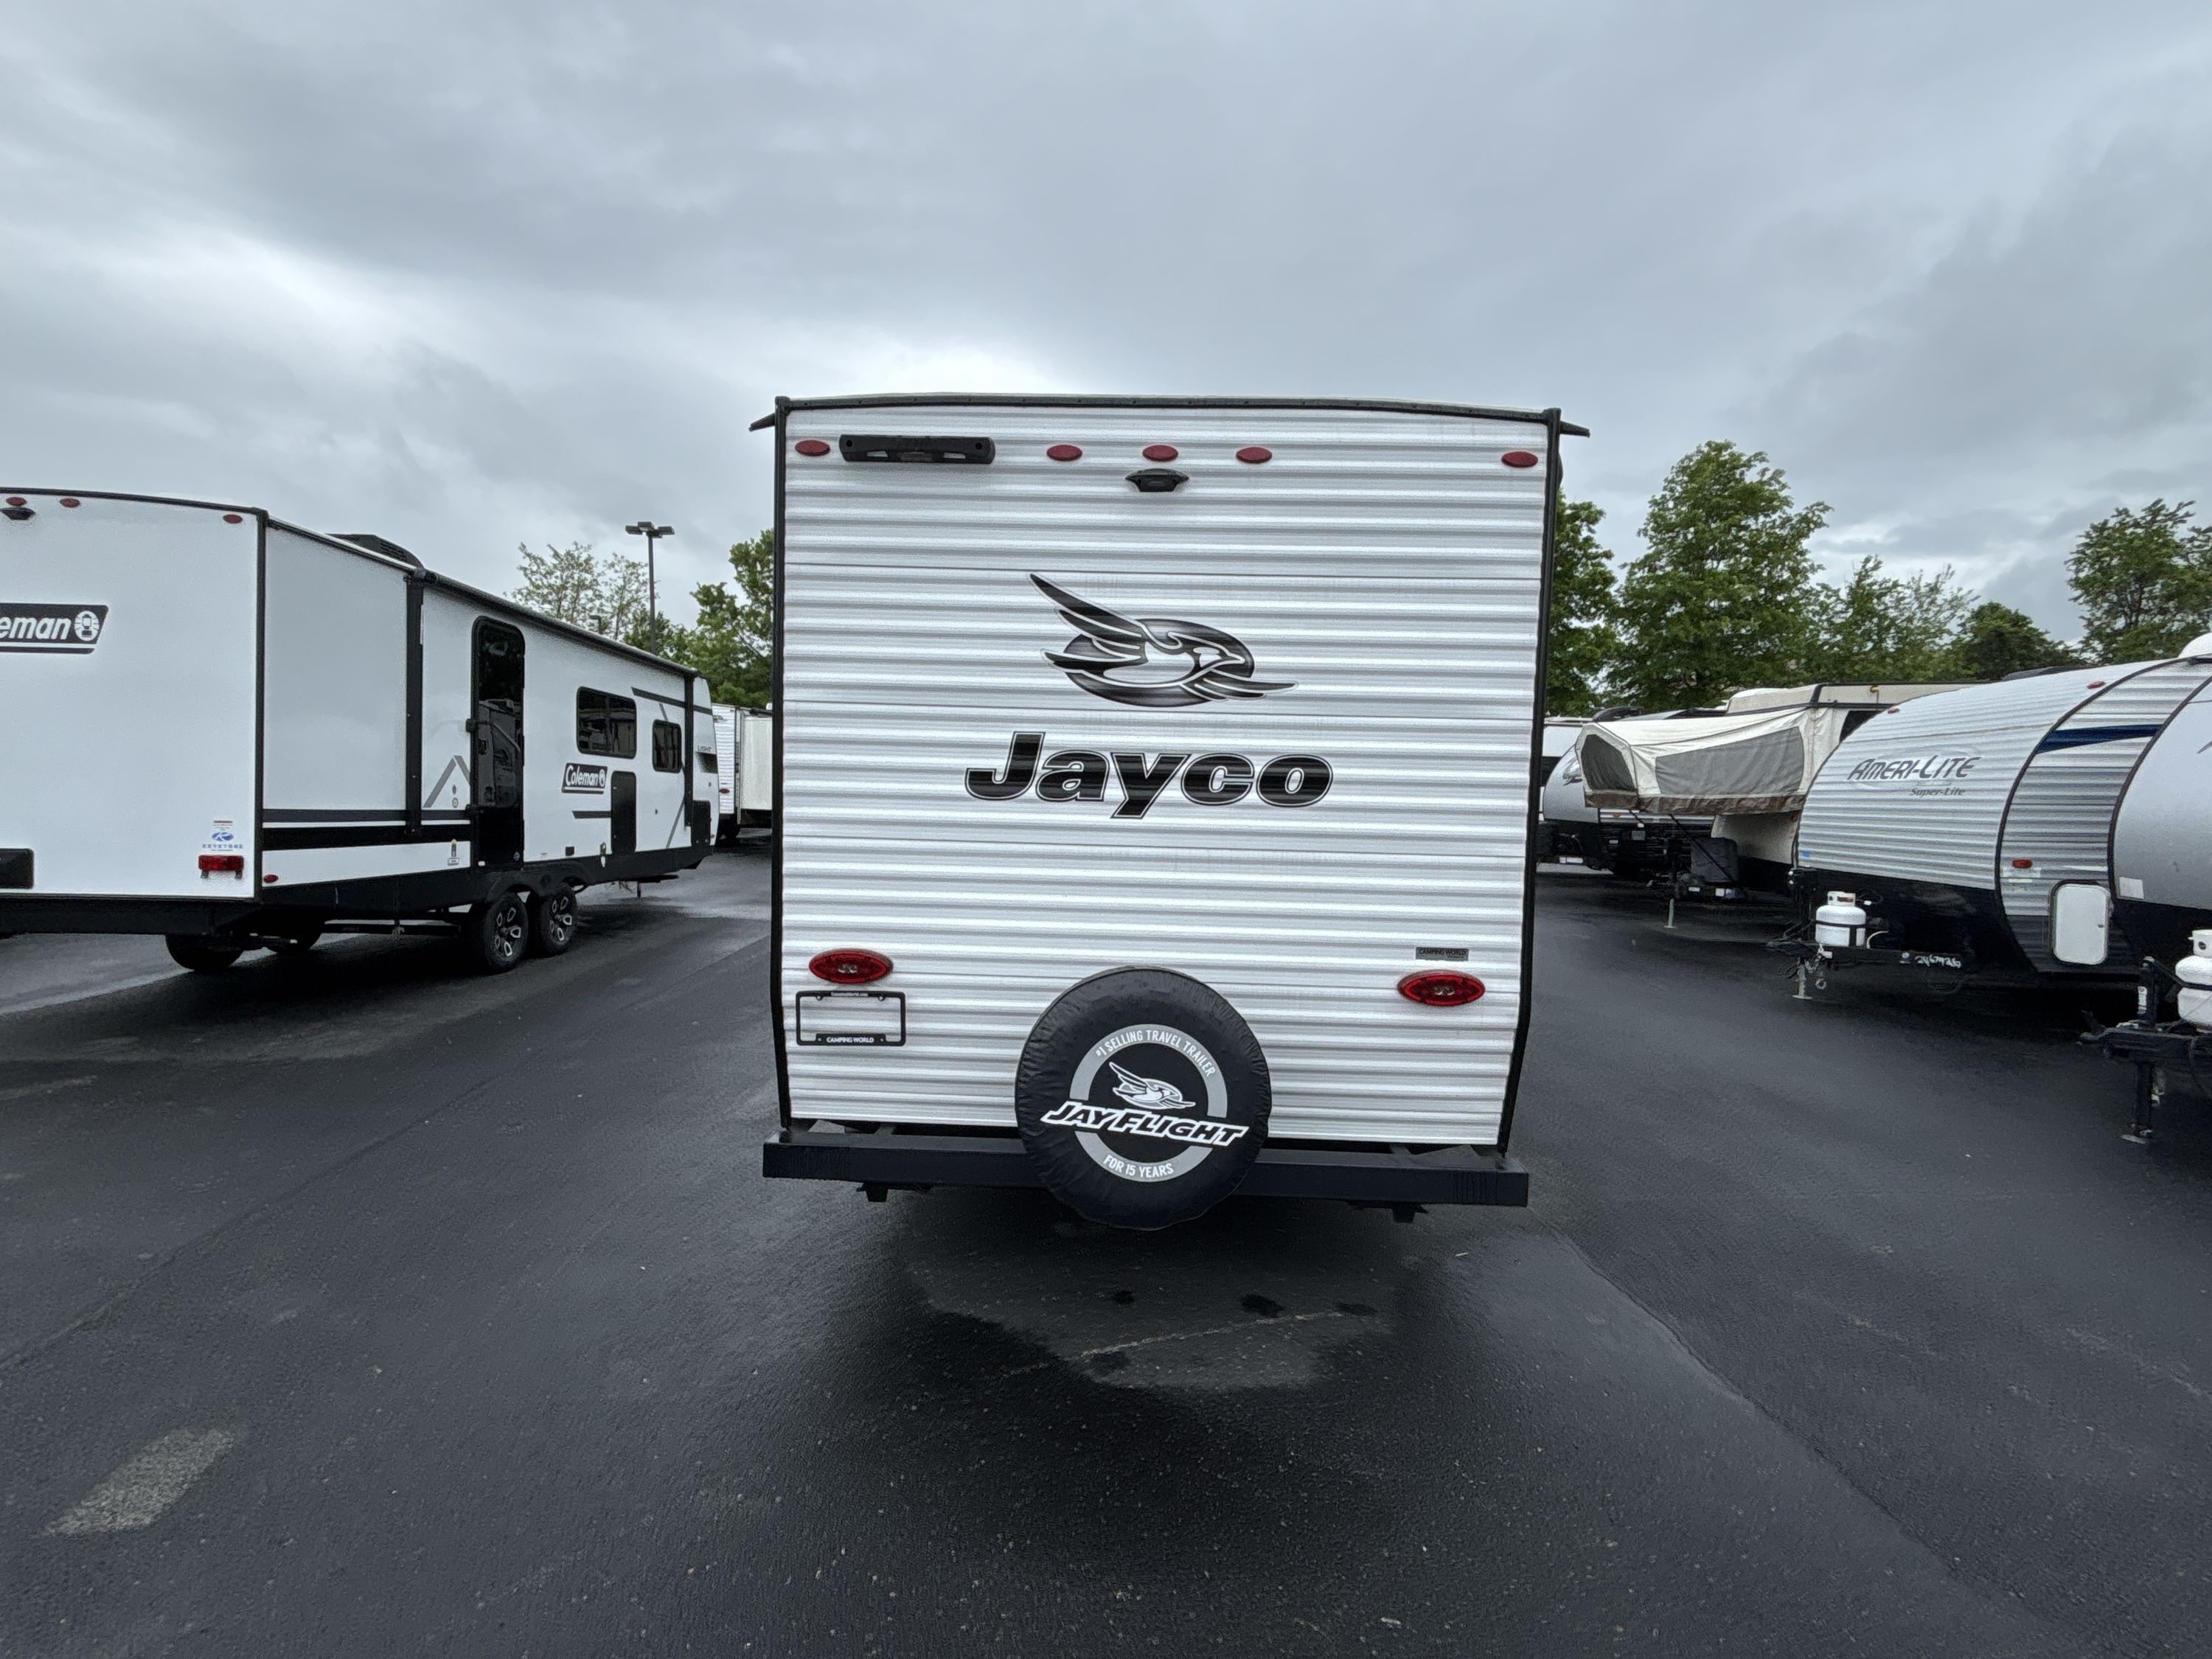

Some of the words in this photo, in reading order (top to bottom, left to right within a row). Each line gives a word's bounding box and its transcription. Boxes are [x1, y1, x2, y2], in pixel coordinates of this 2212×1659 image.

[565, 765, 599, 787] Coleman
[964, 731, 1333, 819] Jayco
[1910, 787, 1966, 797] Super-Lite
[1096, 1046, 1107, 1057] #1
[1105, 1030, 1143, 1052] SELLING
[1146, 1030, 1180, 1048] TRAVEL
[1183, 1040, 1216, 1077] TRAILER
[1104, 1154, 1123, 1171] FOR
[1125, 1165, 1136, 1176] 15
[1139, 1163, 1174, 1178] YEARS
